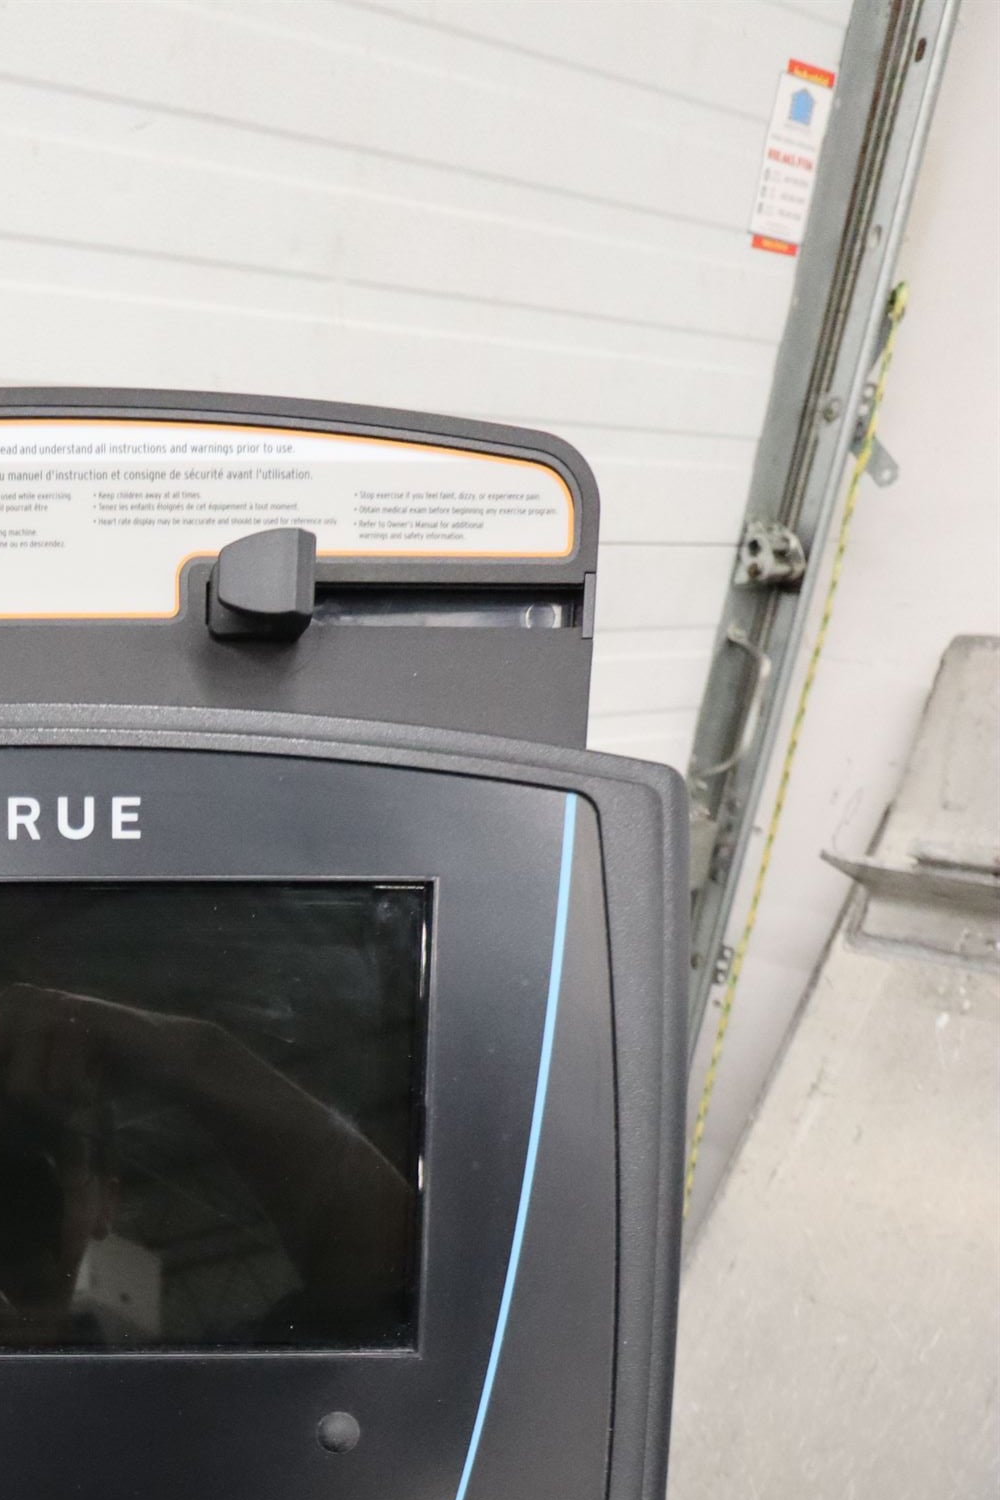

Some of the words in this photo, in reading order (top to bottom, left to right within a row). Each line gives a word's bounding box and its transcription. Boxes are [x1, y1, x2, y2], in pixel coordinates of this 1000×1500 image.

[19, 443, 36, 455] and
[39, 443, 92, 455] understand
[95, 443, 106, 454] all
[110, 443, 166, 454] instructions
[170, 443, 187, 454] and
[190, 443, 234, 457] warnings
[236, 443, 260, 457] prior
[264, 443, 273, 454] to
[276, 446, 296, 454] use.
[8, 470, 42, 482] manuel
[46, 470, 108, 481] d'instruction
[111, 470, 120, 481] et
[124, 470, 166, 483] consigne
[170, 469, 181, 481] de
[184, 469, 223, 481] sécurité
[226, 469, 252, 480] avant
[256, 469, 313, 480] l'utilisation.
